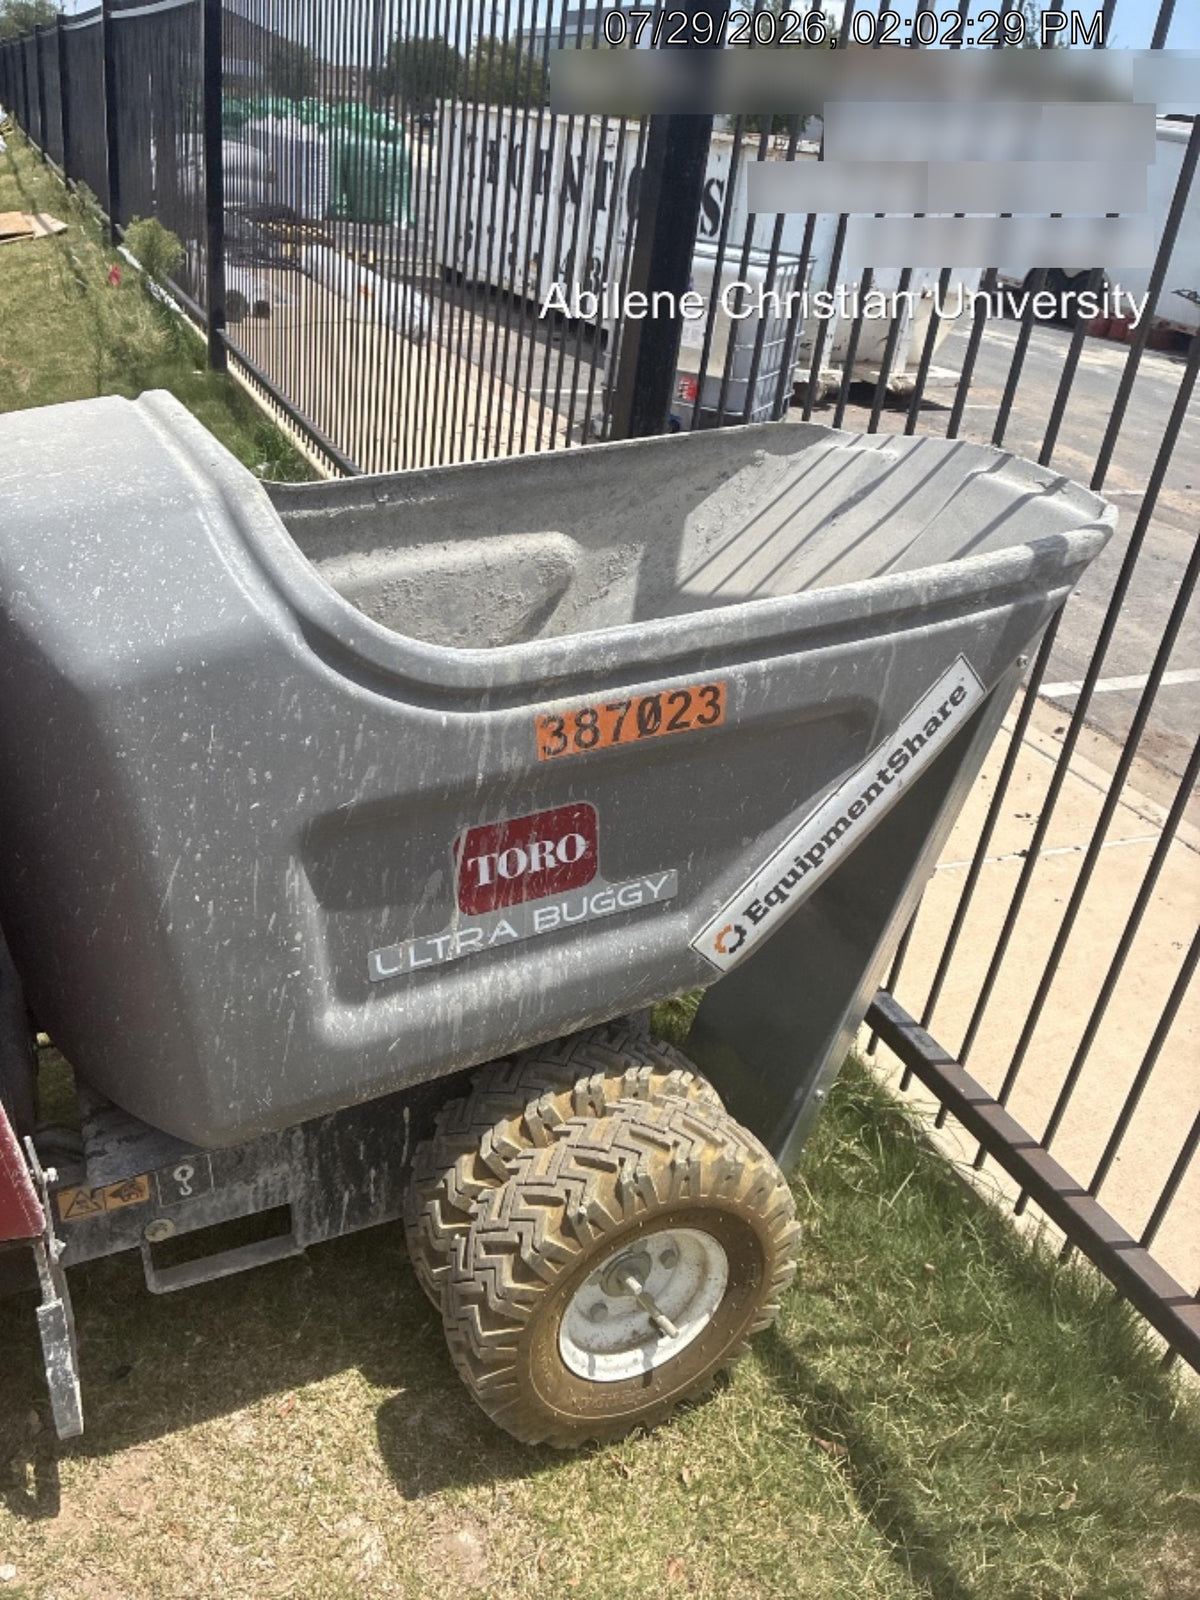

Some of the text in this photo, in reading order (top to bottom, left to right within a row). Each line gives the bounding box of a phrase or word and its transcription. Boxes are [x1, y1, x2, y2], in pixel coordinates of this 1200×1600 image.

[540, 685, 722, 756] 387023
[742, 685, 968, 925] EquipmentShare
[467, 833, 587, 888] TORO
[374, 875, 669, 974] ULTRA BUGGY
